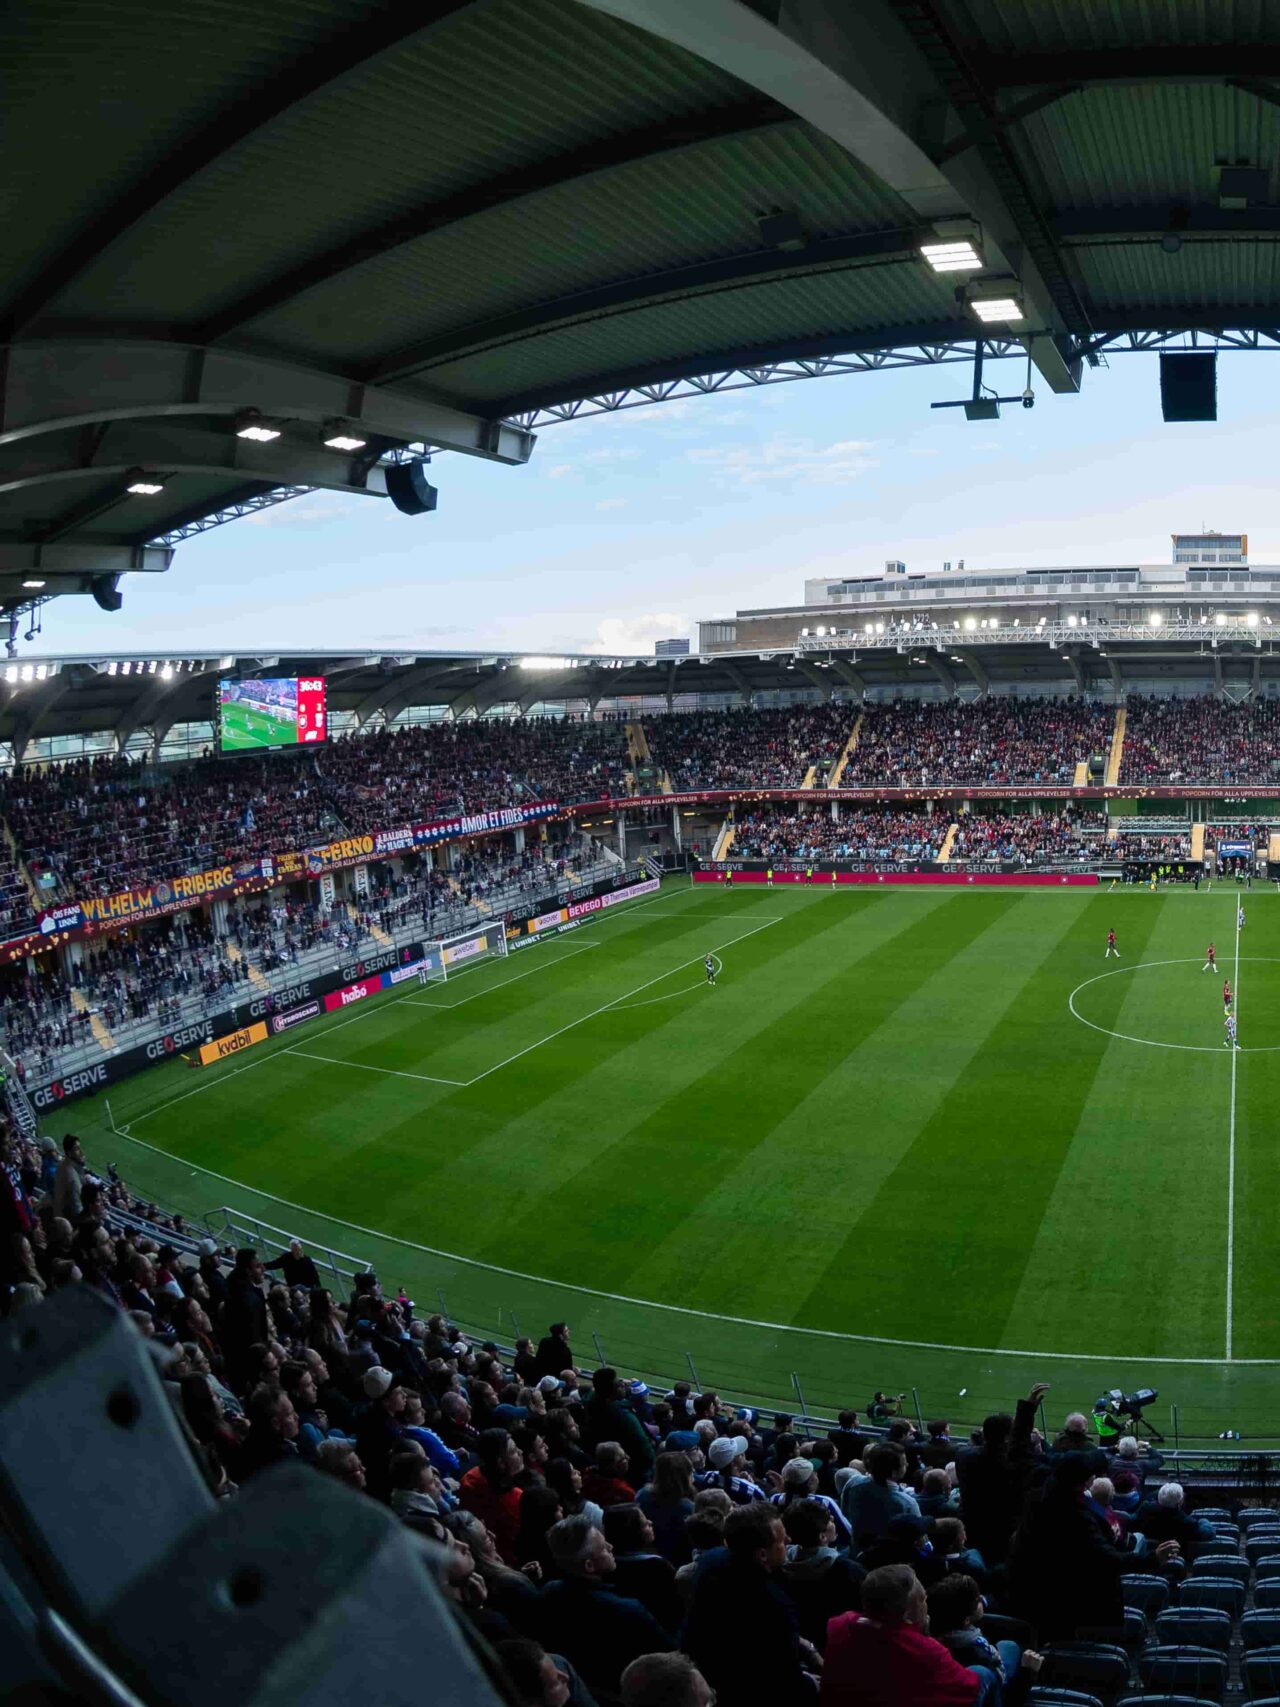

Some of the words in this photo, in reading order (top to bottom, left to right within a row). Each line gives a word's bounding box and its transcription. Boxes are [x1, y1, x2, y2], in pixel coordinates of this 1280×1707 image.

[461, 814, 488, 834] AMOR
[489, 811, 500, 827] ET
[500, 807, 524, 825] FIDES
[303, 835, 375, 869] IFERNO
[700, 863, 743, 871] GEOSERVE
[942, 864, 1002, 873] GEOSERVE
[80, 889, 153, 920] WILHELM
[173, 866, 234, 899] FRIBERG
[558, 886, 594, 904] GEOSERVE
[63, 905, 81, 916] FANS
[145, 908, 161, 918] ALLA
[569, 899, 601, 917] BEVEGO
[558, 919, 581, 932] UNIBET
[457, 942, 476, 953] weber
[515, 934, 541, 948] UNIBET
[343, 952, 397, 981] GEOSERVE
[341, 985, 367, 1004] habo
[146, 1021, 215, 1059] GEOSERVE
[217, 1029, 252, 1057] kvdbil
[34, 1064, 108, 1107] GEOSERVE
